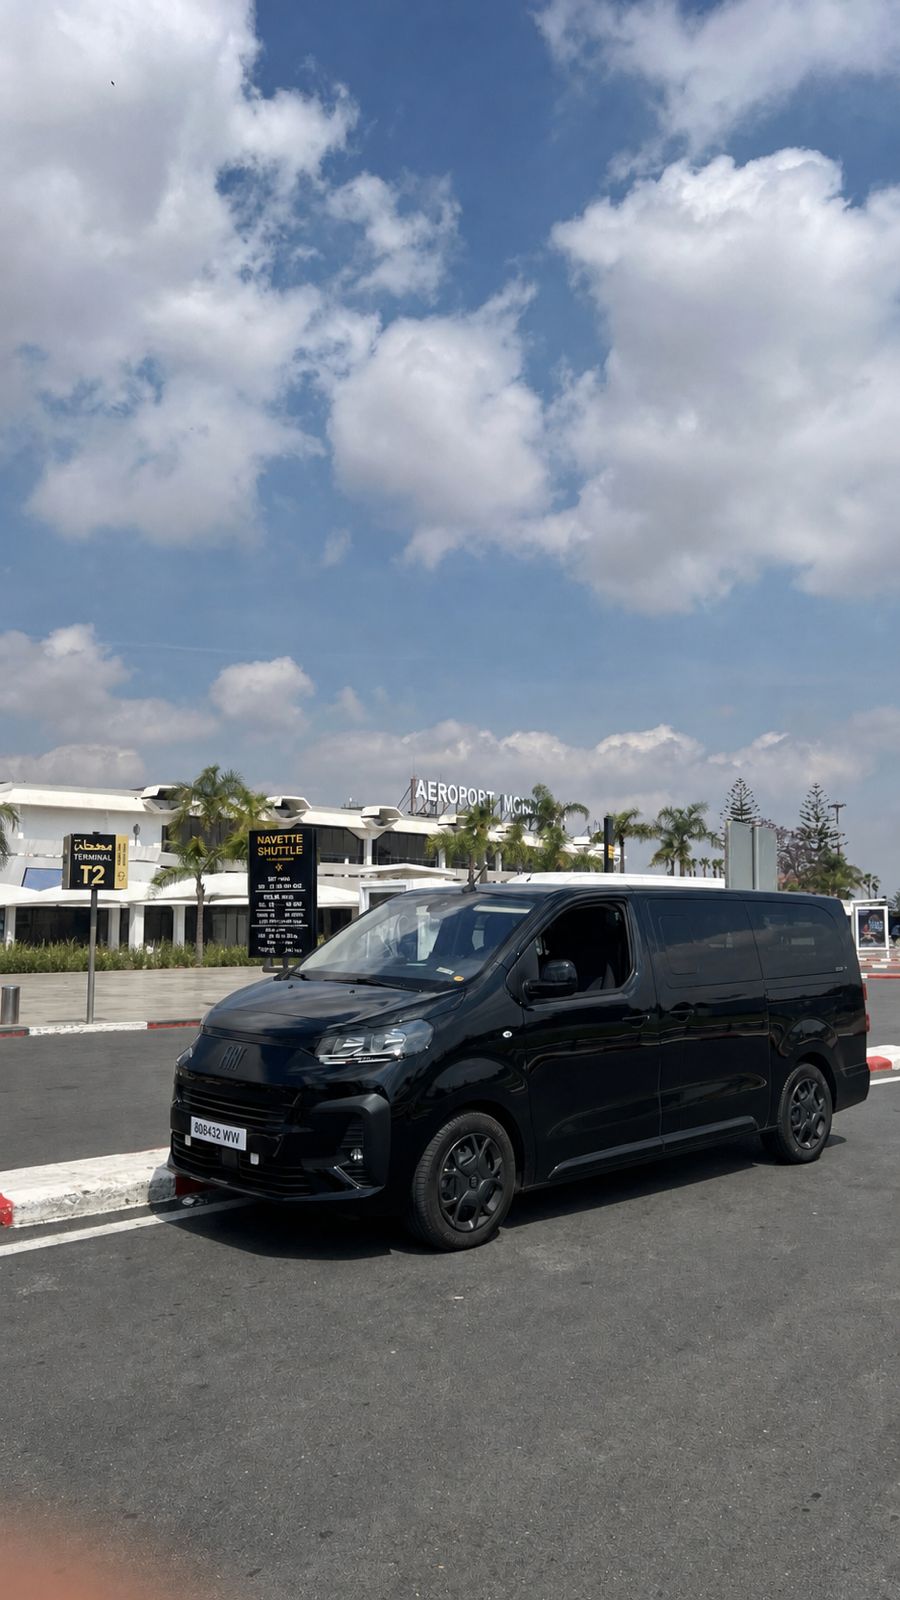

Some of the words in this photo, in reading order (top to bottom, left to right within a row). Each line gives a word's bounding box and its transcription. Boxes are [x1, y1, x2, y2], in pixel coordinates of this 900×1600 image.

[415, 779, 495, 810] AEROPORT
[257, 834, 304, 844] NAVETTE
[74, 853, 112, 861] TERMINAL
[257, 845, 303, 856] SHUTTLE
[80, 864, 105, 884] T2
[222, 1128, 240, 1144] WW
